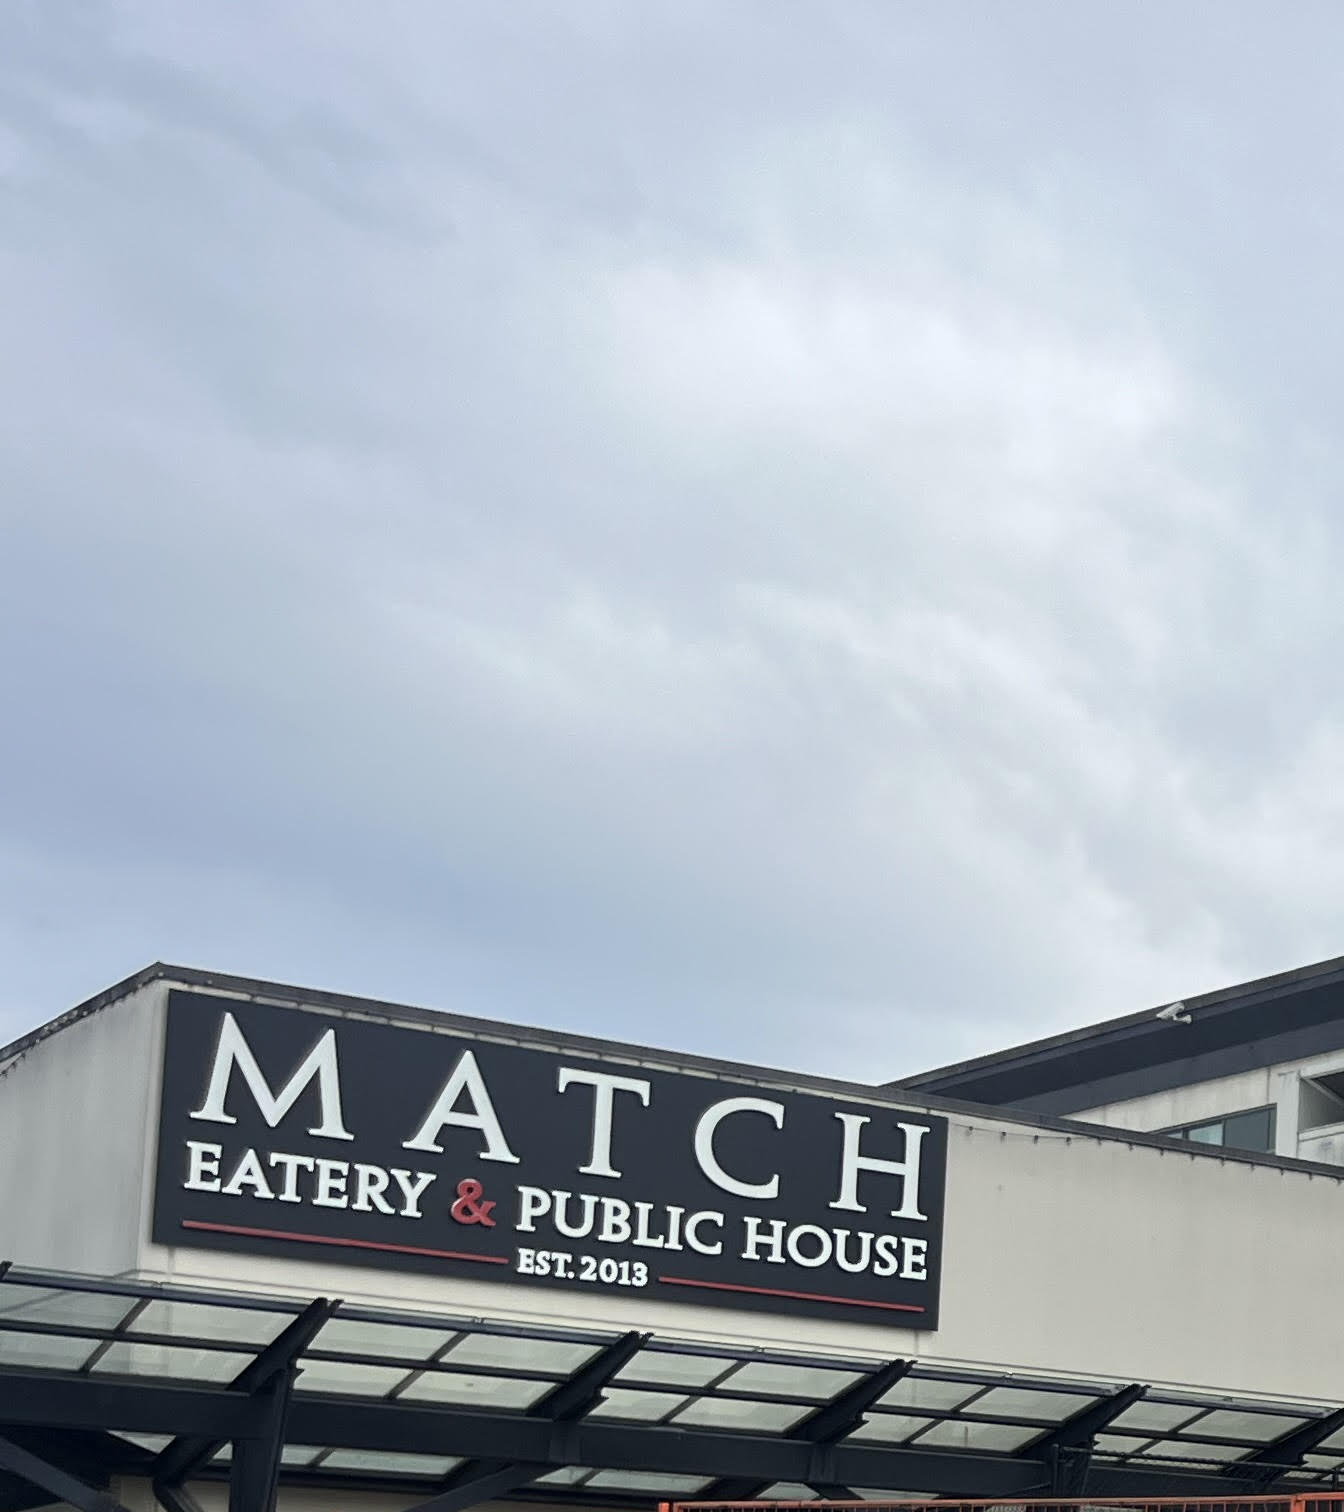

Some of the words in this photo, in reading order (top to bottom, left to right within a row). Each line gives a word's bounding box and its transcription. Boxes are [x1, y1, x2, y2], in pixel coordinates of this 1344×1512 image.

[189, 1010, 932, 1222] MATCH
[184, 1140, 437, 1219] EATERY
[451, 1178, 497, 1227] &
[515, 1185, 724, 1256] PUBLIC
[741, 1216, 928, 1281] HOUSE
[516, 1248, 575, 1281] EST.
[579, 1257, 649, 1287] 2013
